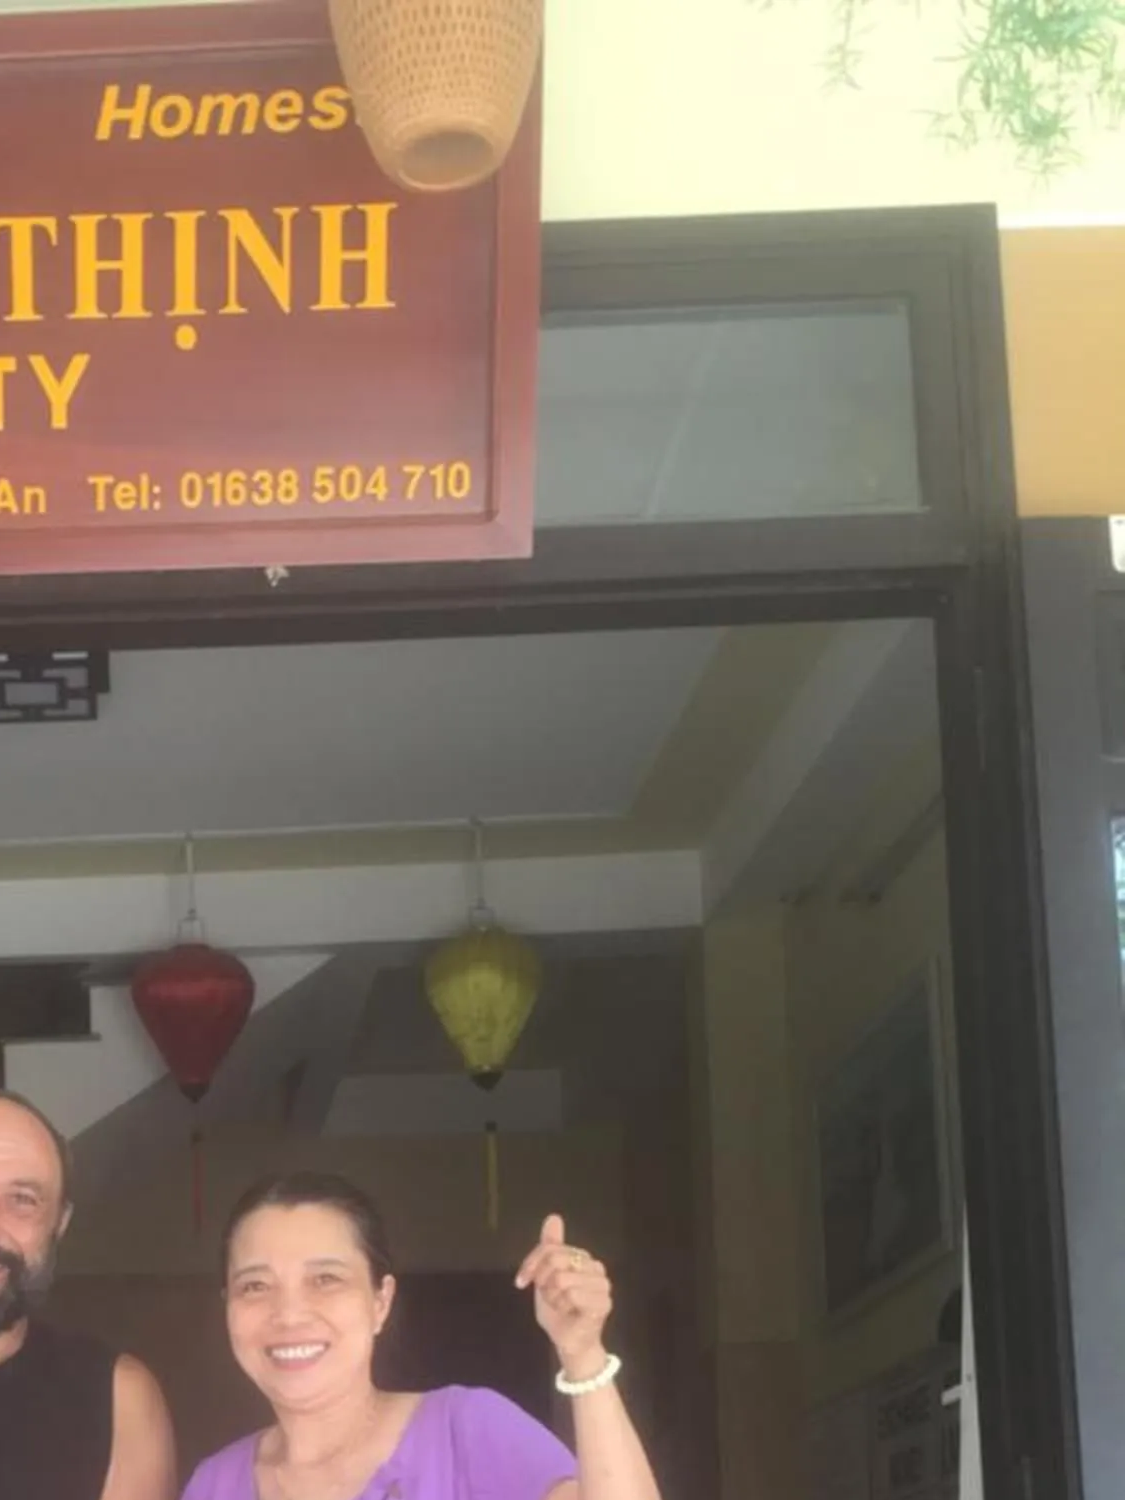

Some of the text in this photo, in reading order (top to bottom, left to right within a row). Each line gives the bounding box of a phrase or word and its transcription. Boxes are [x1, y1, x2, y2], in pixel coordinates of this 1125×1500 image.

[95, 83, 351, 141] Homes
[87, 474, 163, 511] Tel:
[179, 467, 300, 508] 01638
[312, 464, 388, 504] 504
[402, 461, 472, 500] 710
